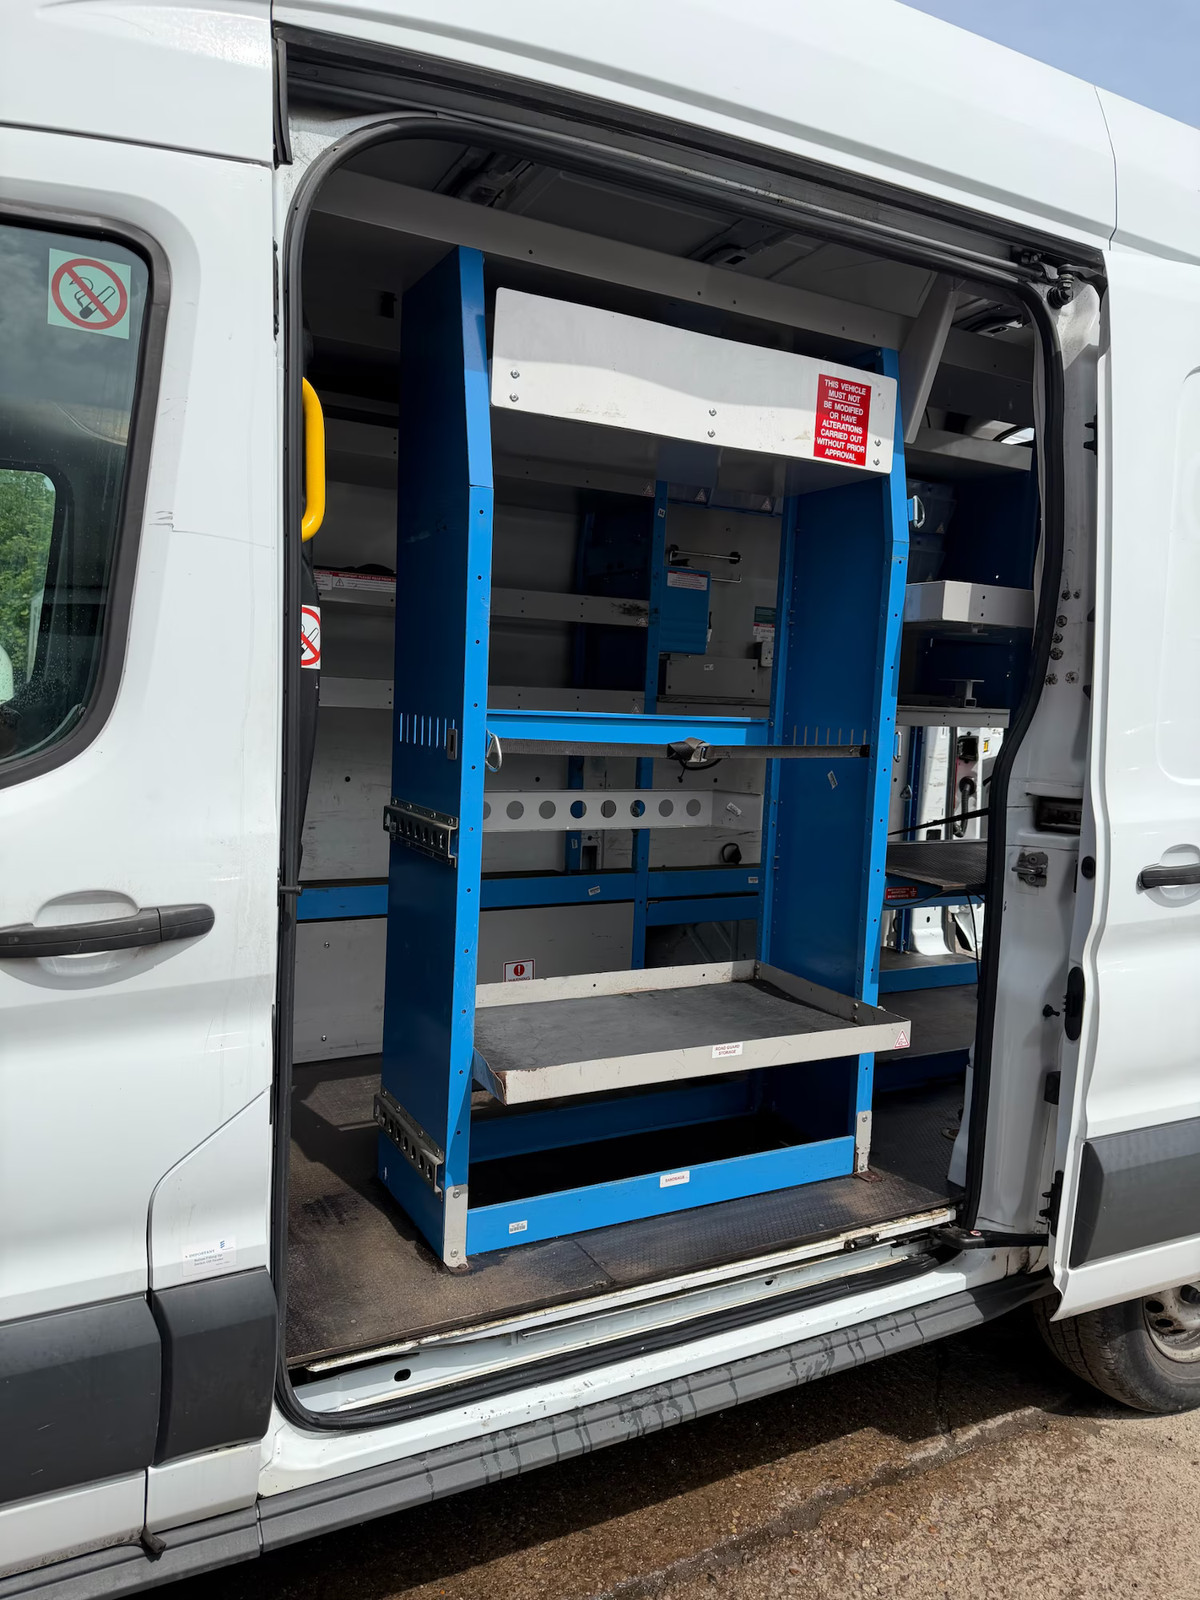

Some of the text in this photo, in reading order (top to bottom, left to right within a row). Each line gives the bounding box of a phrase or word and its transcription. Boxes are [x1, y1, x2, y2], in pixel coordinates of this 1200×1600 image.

[825, 379, 866, 395] THIS VEHICLE
[828, 390, 860, 403] MUST NOT
[834, 404, 864, 416] MODIFIED
[830, 412, 857, 424] OR HAVE
[822, 419, 862, 434] ALTERATIONS
[820, 428, 862, 444] CARRIED OUT
[816, 437, 865, 453] WITHOUT PRIOR
[824, 448, 856, 461] APPROVAL
